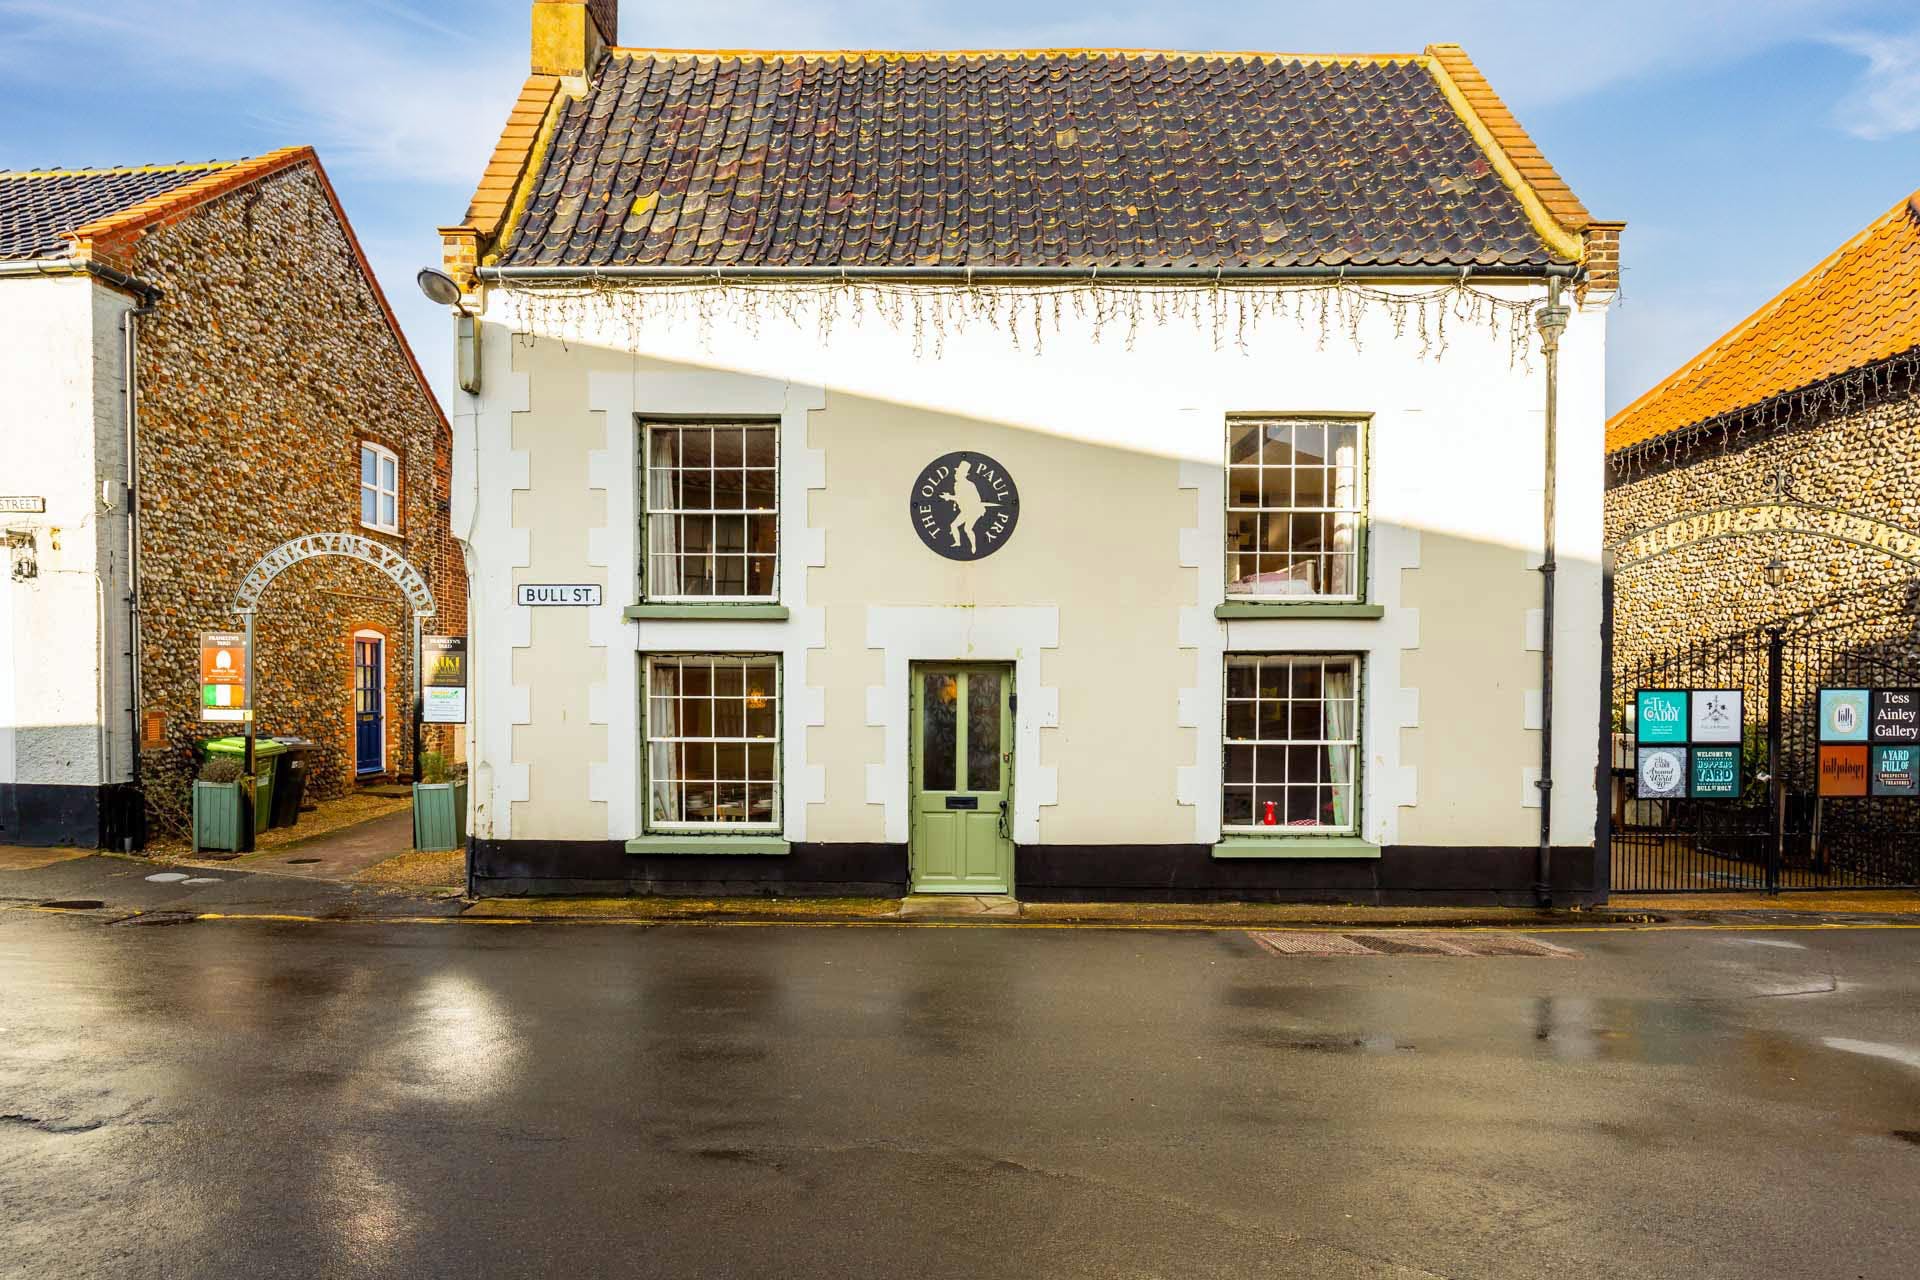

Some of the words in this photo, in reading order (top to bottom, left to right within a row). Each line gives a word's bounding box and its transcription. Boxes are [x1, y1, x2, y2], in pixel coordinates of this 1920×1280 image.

[921, 465, 950, 498] OLD
[975, 462, 1009, 502] PAUL
[0, 499, 39, 510] STREET
[919, 504, 941, 540] THE
[984, 512, 1009, 543] PRY
[380, 549, 432, 607] YARD
[526, 588, 568, 602] BULL
[573, 588, 596, 602] ST.
[1650, 697, 1672, 711] TEA
[1883, 692, 1910, 704] Tess
[1643, 706, 1681, 721] CADDY
[1877, 708, 1917, 723] Ainley
[1874, 724, 1919, 740] Gallery
[1882, 750, 1888, 760] A
[1888, 750, 1910, 761] YARD
[1882, 760, 1901, 772] FULL
[1900, 761, 1910, 770] OF
[1696, 768, 1734, 782] YARD
